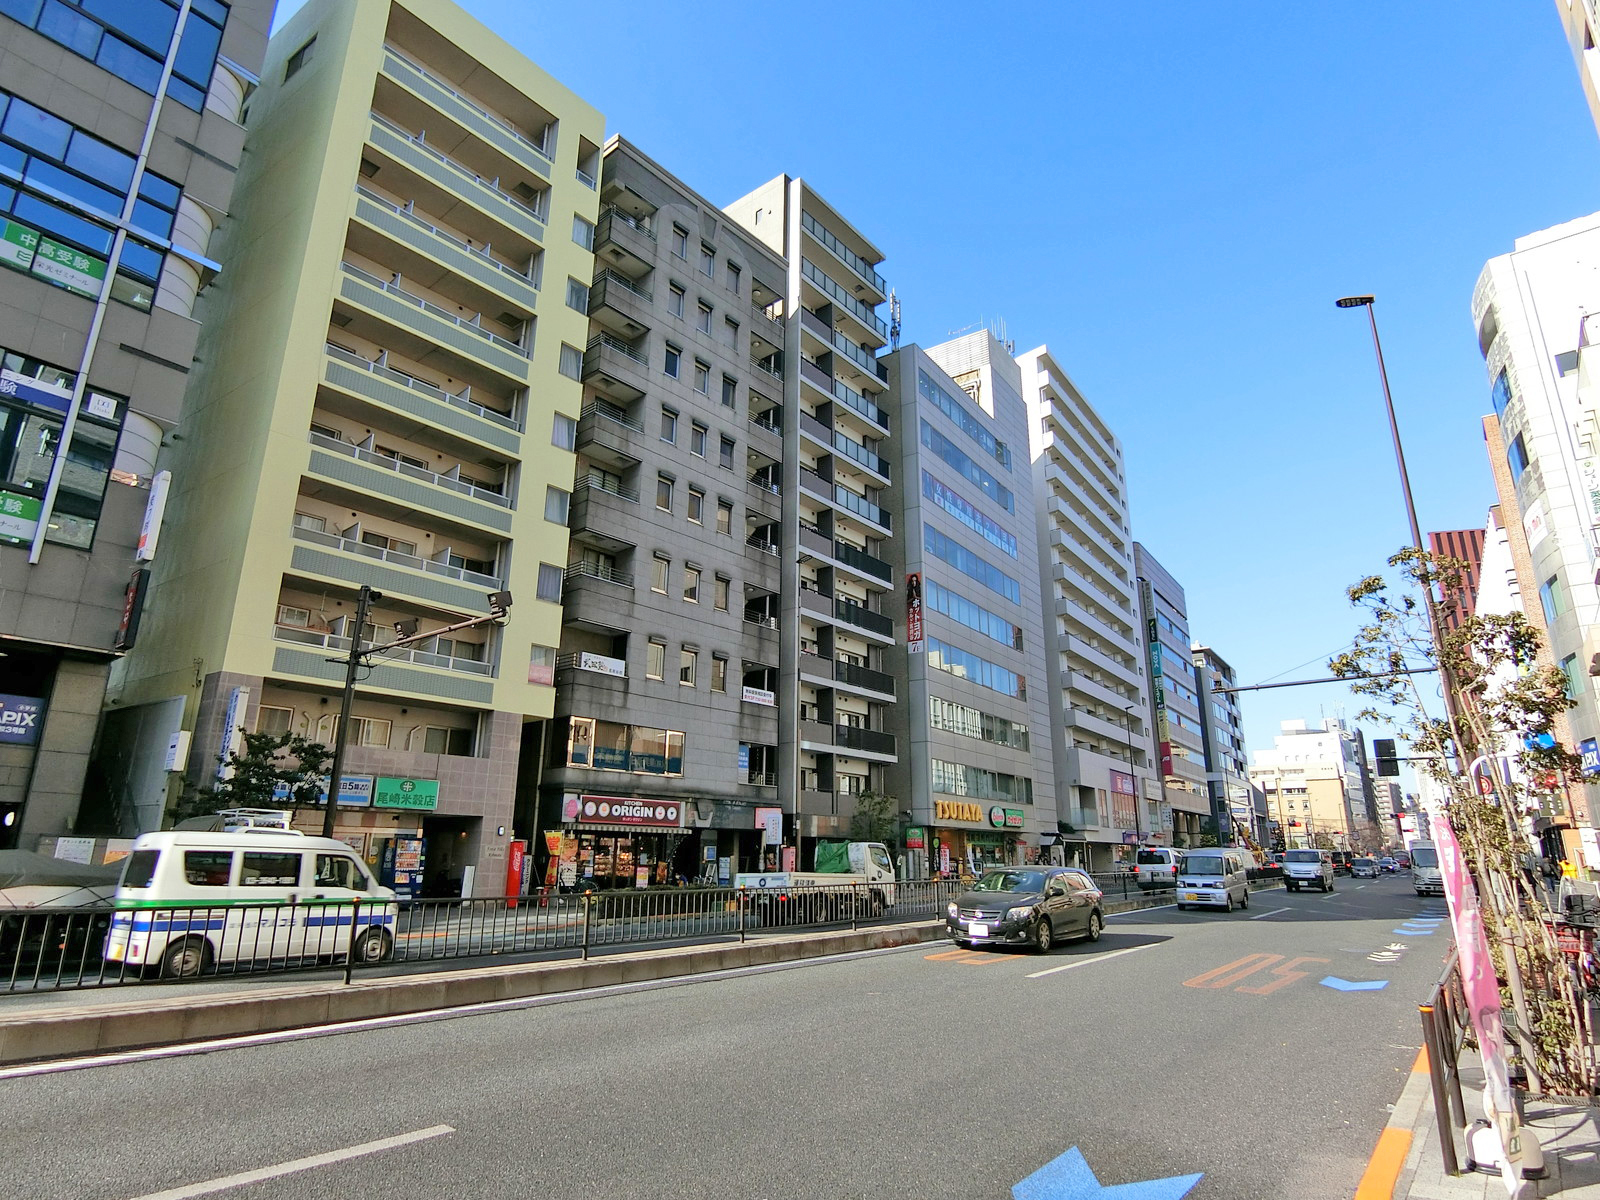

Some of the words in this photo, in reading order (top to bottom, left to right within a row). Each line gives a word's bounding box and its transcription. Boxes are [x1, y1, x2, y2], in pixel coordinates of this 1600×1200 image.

[912, 598, 921, 640] ホットヨガ
[0, 711, 37, 727] PIX
[612, 804, 654, 818] ORIGIN
[935, 800, 984, 822] TSUTAYA
